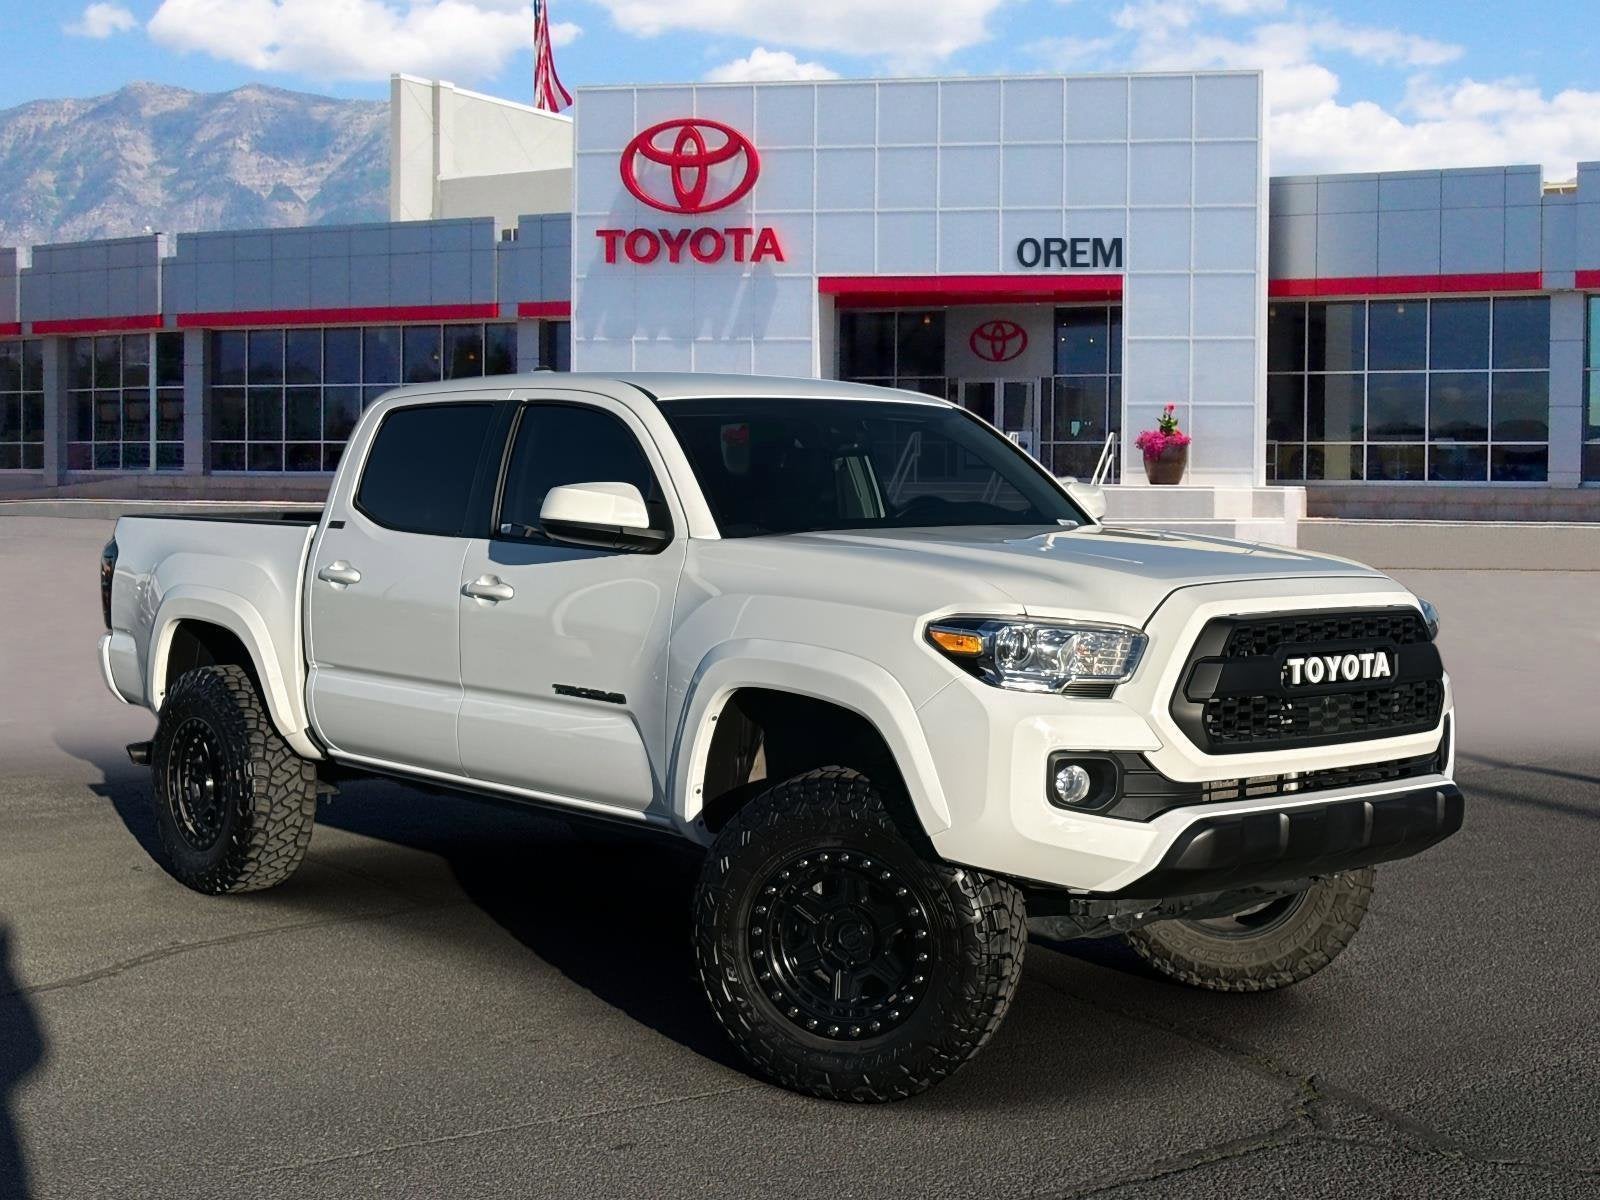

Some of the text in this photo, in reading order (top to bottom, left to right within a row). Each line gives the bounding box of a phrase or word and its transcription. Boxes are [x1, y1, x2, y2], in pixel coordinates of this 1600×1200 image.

[596, 228, 784, 264] TOYOTA
[1017, 238, 1123, 268] OREM
[1287, 652, 1391, 685] TOYOTA
